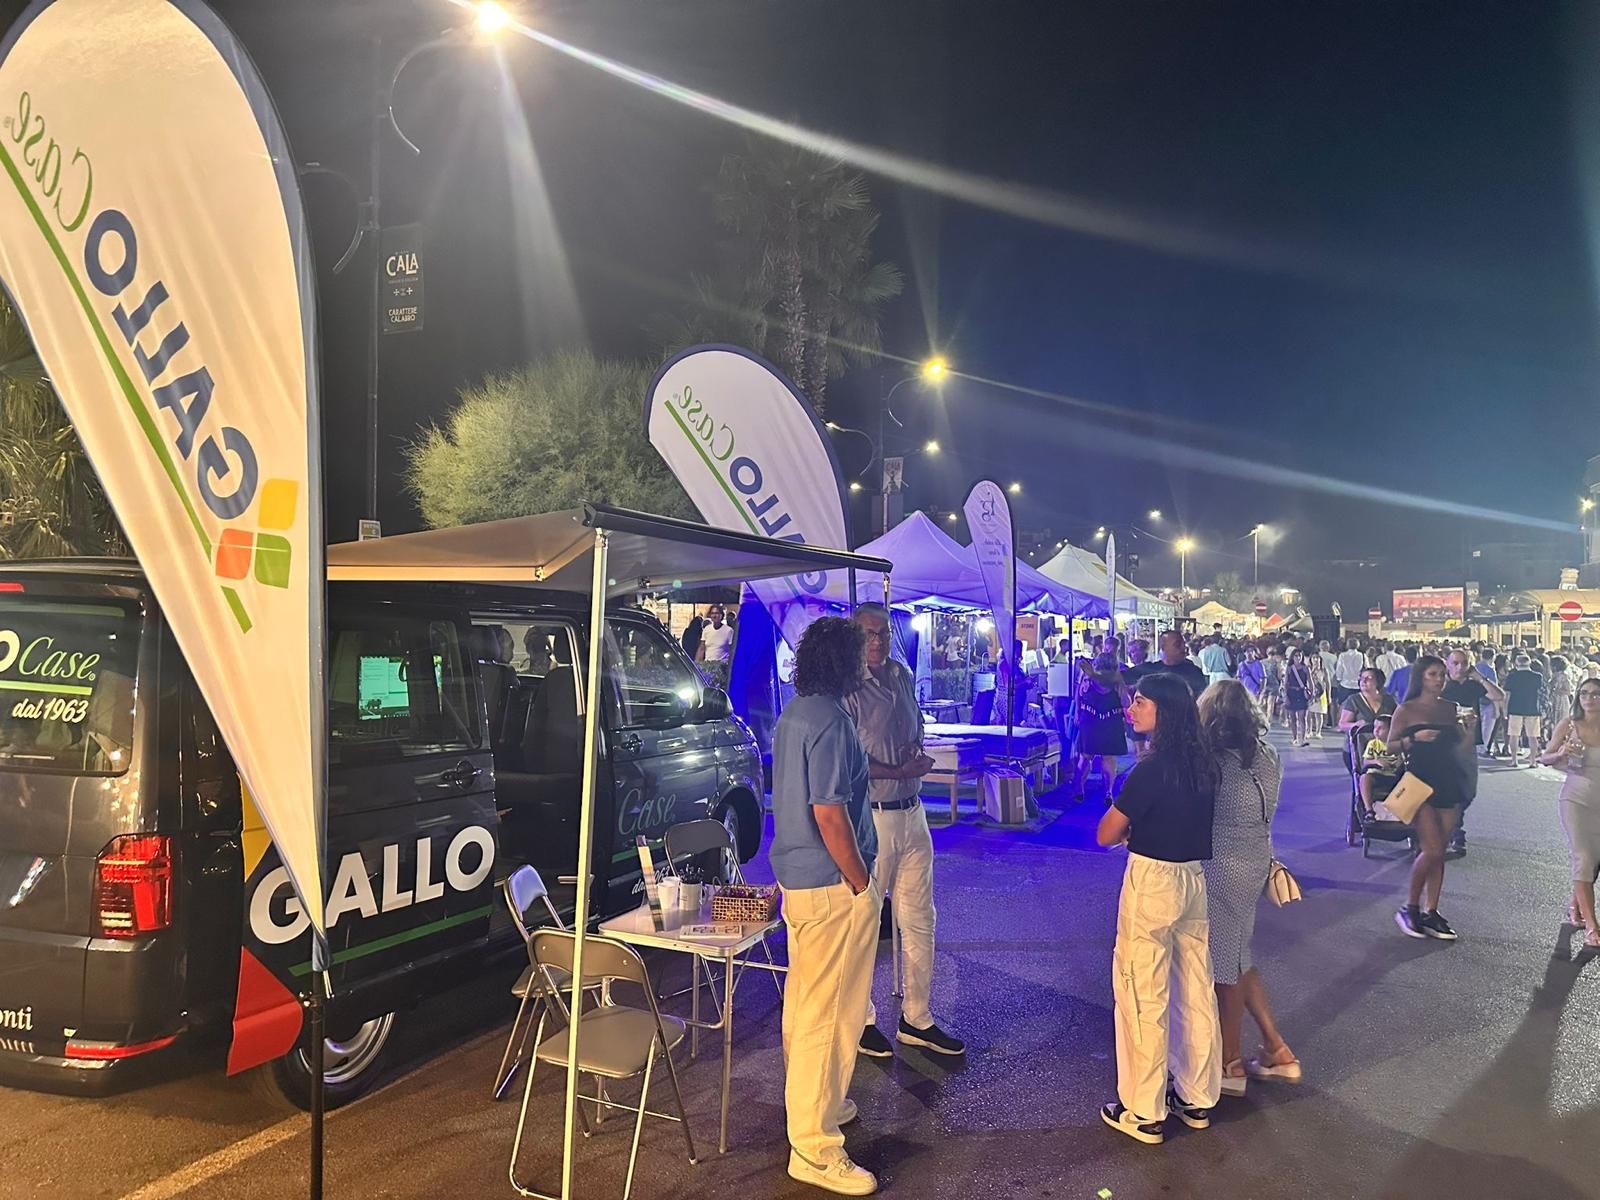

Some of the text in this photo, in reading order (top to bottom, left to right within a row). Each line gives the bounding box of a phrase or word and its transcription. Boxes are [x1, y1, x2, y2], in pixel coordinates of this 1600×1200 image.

[386, 253, 419, 276] CALA
[388, 306, 418, 316] CARATTERE
[390, 314, 416, 323] CALABRO
[12, 698, 89, 723] dal 1963
[249, 825, 495, 945] GALLO
[631, 878, 645, 895] da
